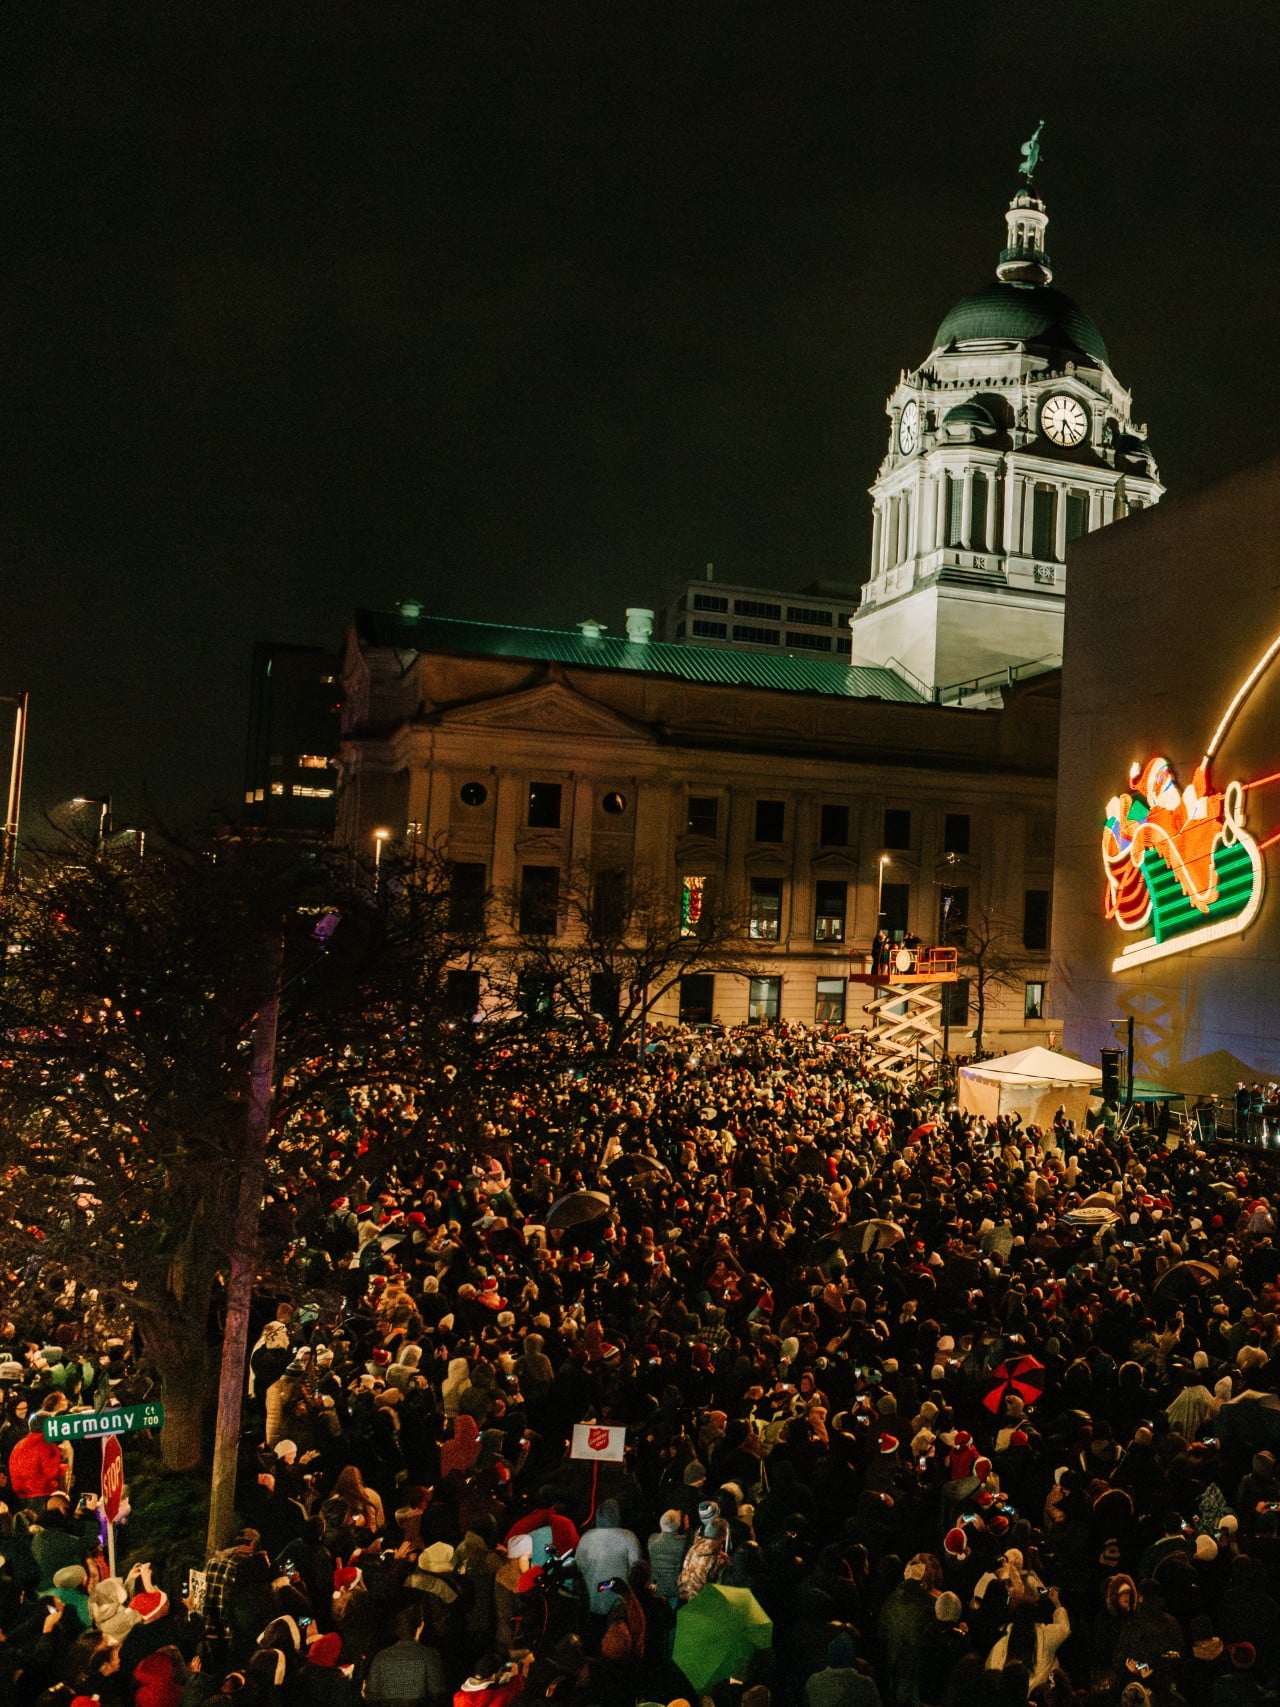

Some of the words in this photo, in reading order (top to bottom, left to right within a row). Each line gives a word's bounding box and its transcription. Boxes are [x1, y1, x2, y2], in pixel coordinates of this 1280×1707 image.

[47, 1413, 134, 1437] Harmony
[145, 1406, 155, 1415] Ct
[143, 1416, 159, 1426] 700
[103, 1455, 121, 1505] STOP
